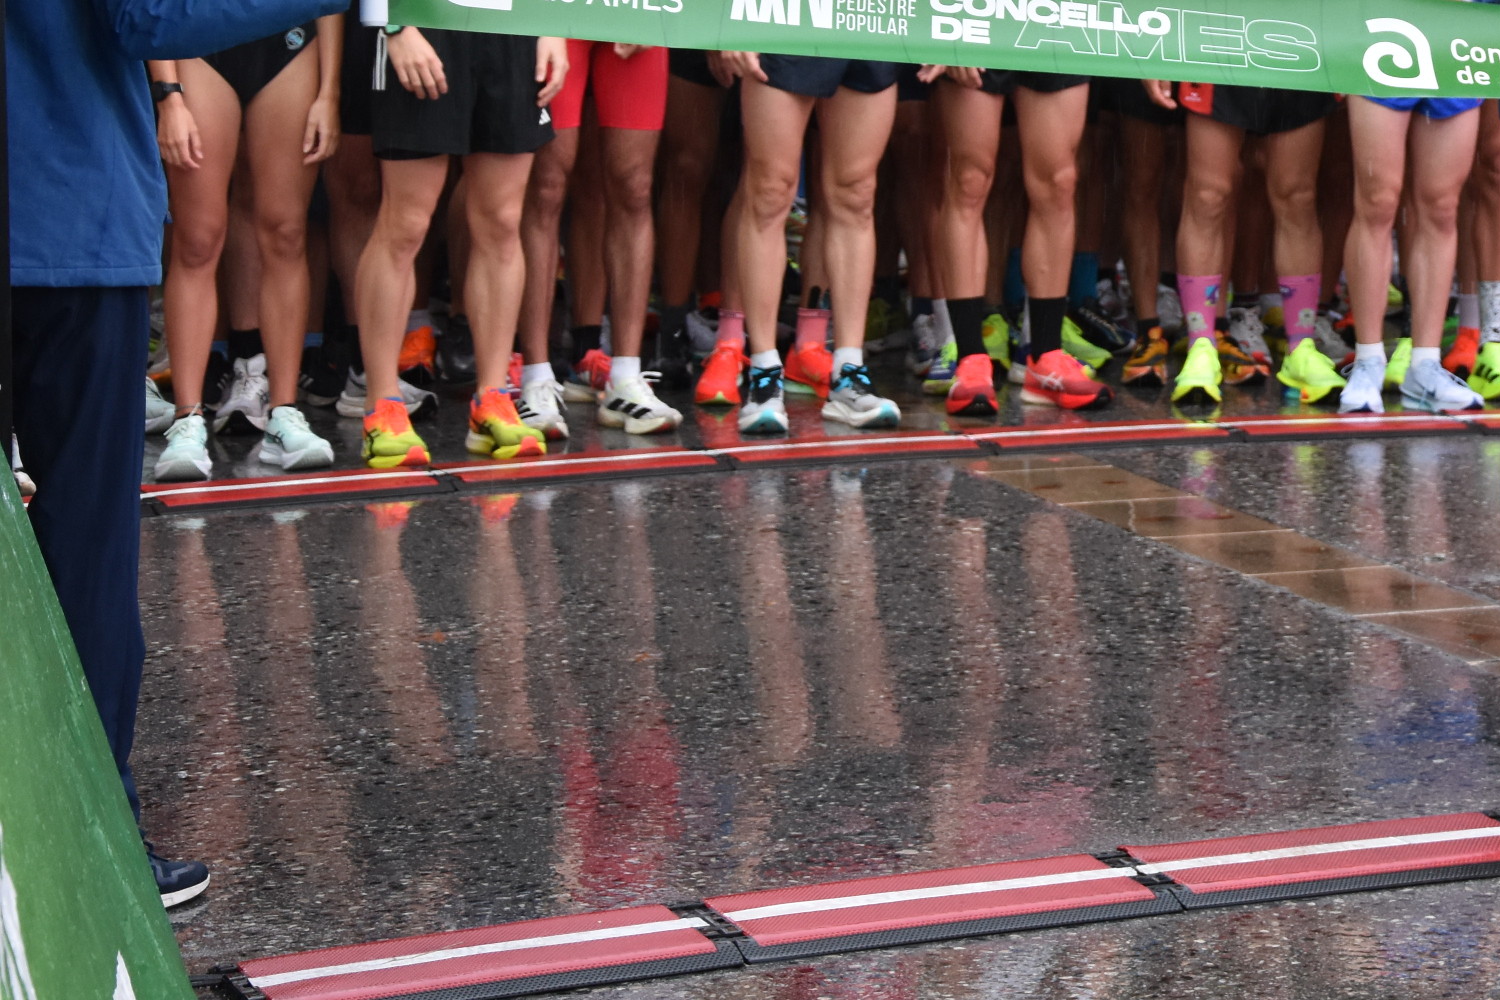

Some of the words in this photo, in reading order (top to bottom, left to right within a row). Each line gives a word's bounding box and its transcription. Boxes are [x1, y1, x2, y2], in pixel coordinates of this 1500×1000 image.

[836, 12, 908, 36] POPULAR
[931, 15, 991, 44] DE
[1456, 65, 1491, 86] de
